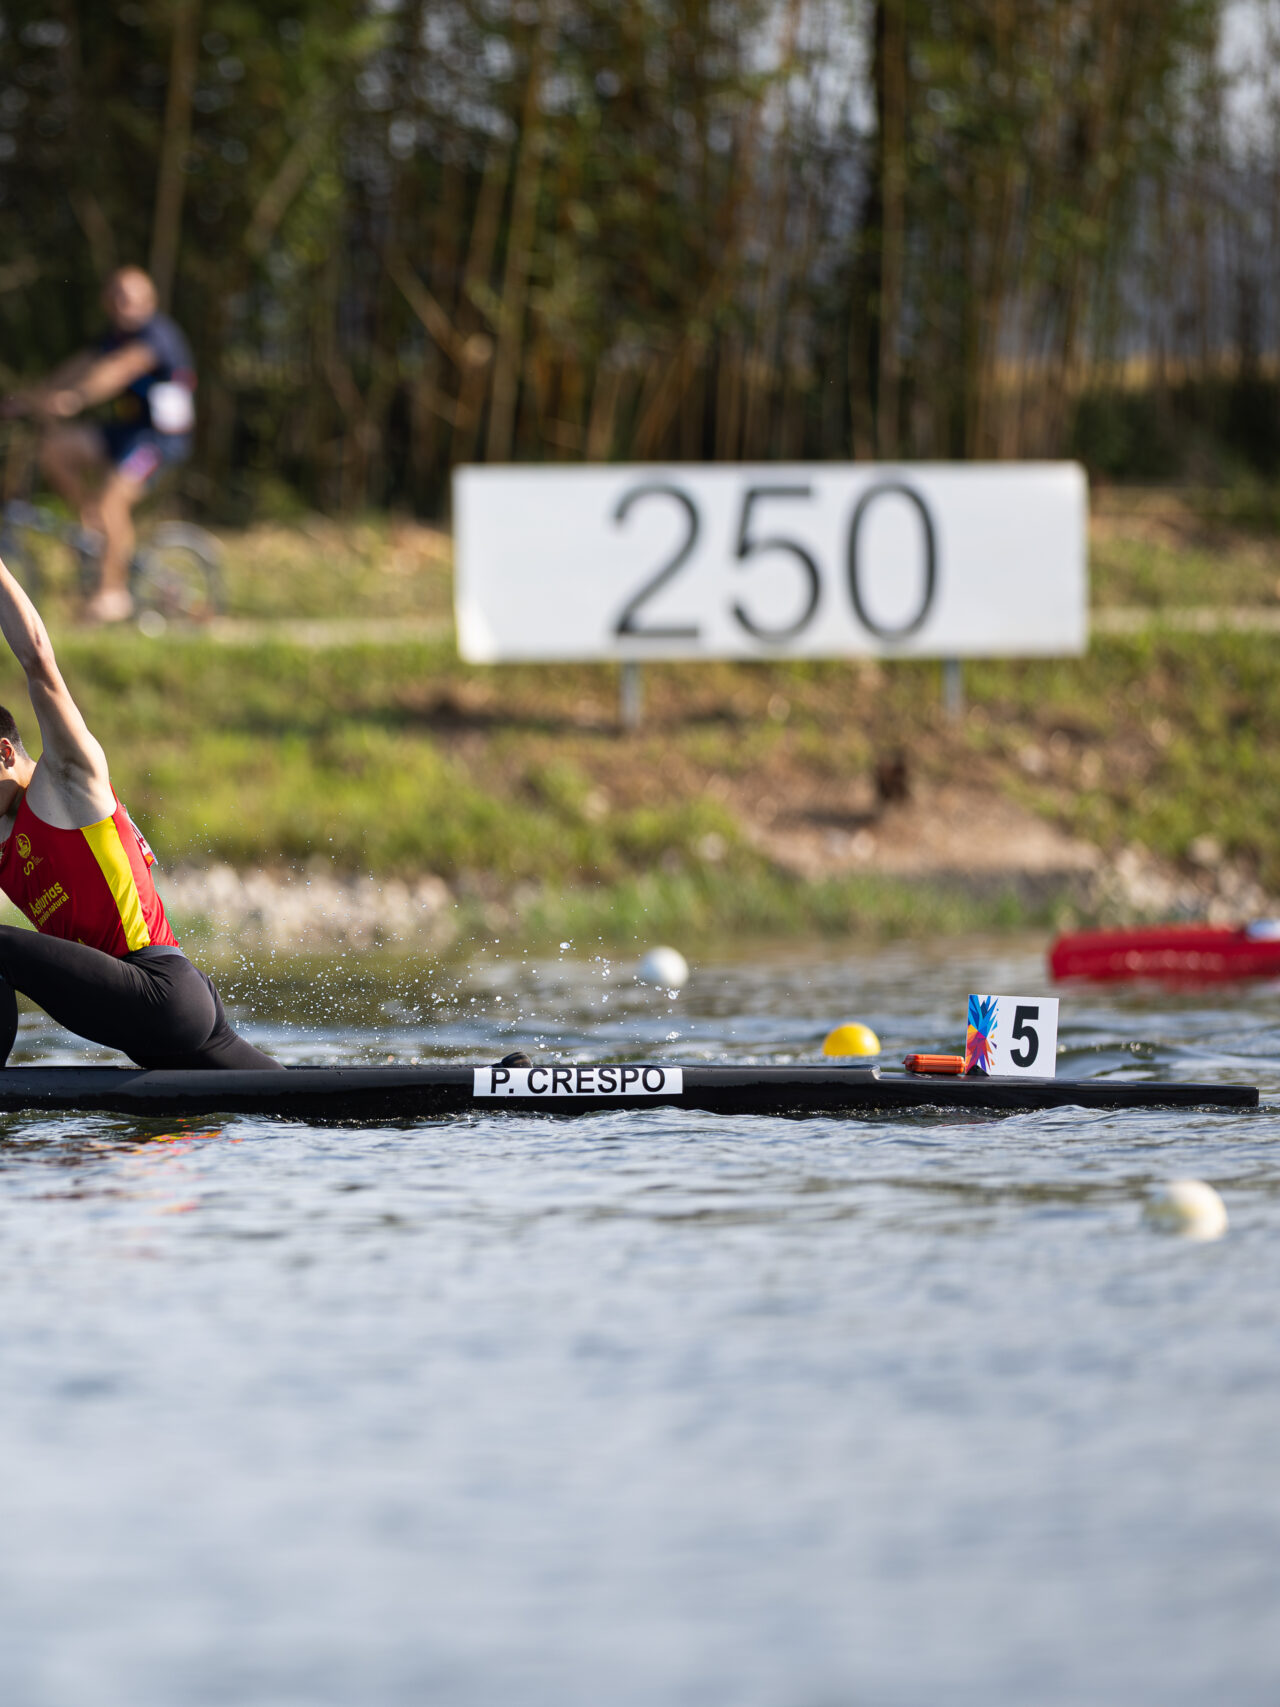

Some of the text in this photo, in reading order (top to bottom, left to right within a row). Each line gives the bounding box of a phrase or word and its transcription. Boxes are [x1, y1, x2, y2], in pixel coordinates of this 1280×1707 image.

[609, 479, 939, 643] 250
[28, 881, 64, 918] Asturias
[1009, 1005, 1040, 1068] 5
[490, 1067, 666, 1094] P. CRESPO
